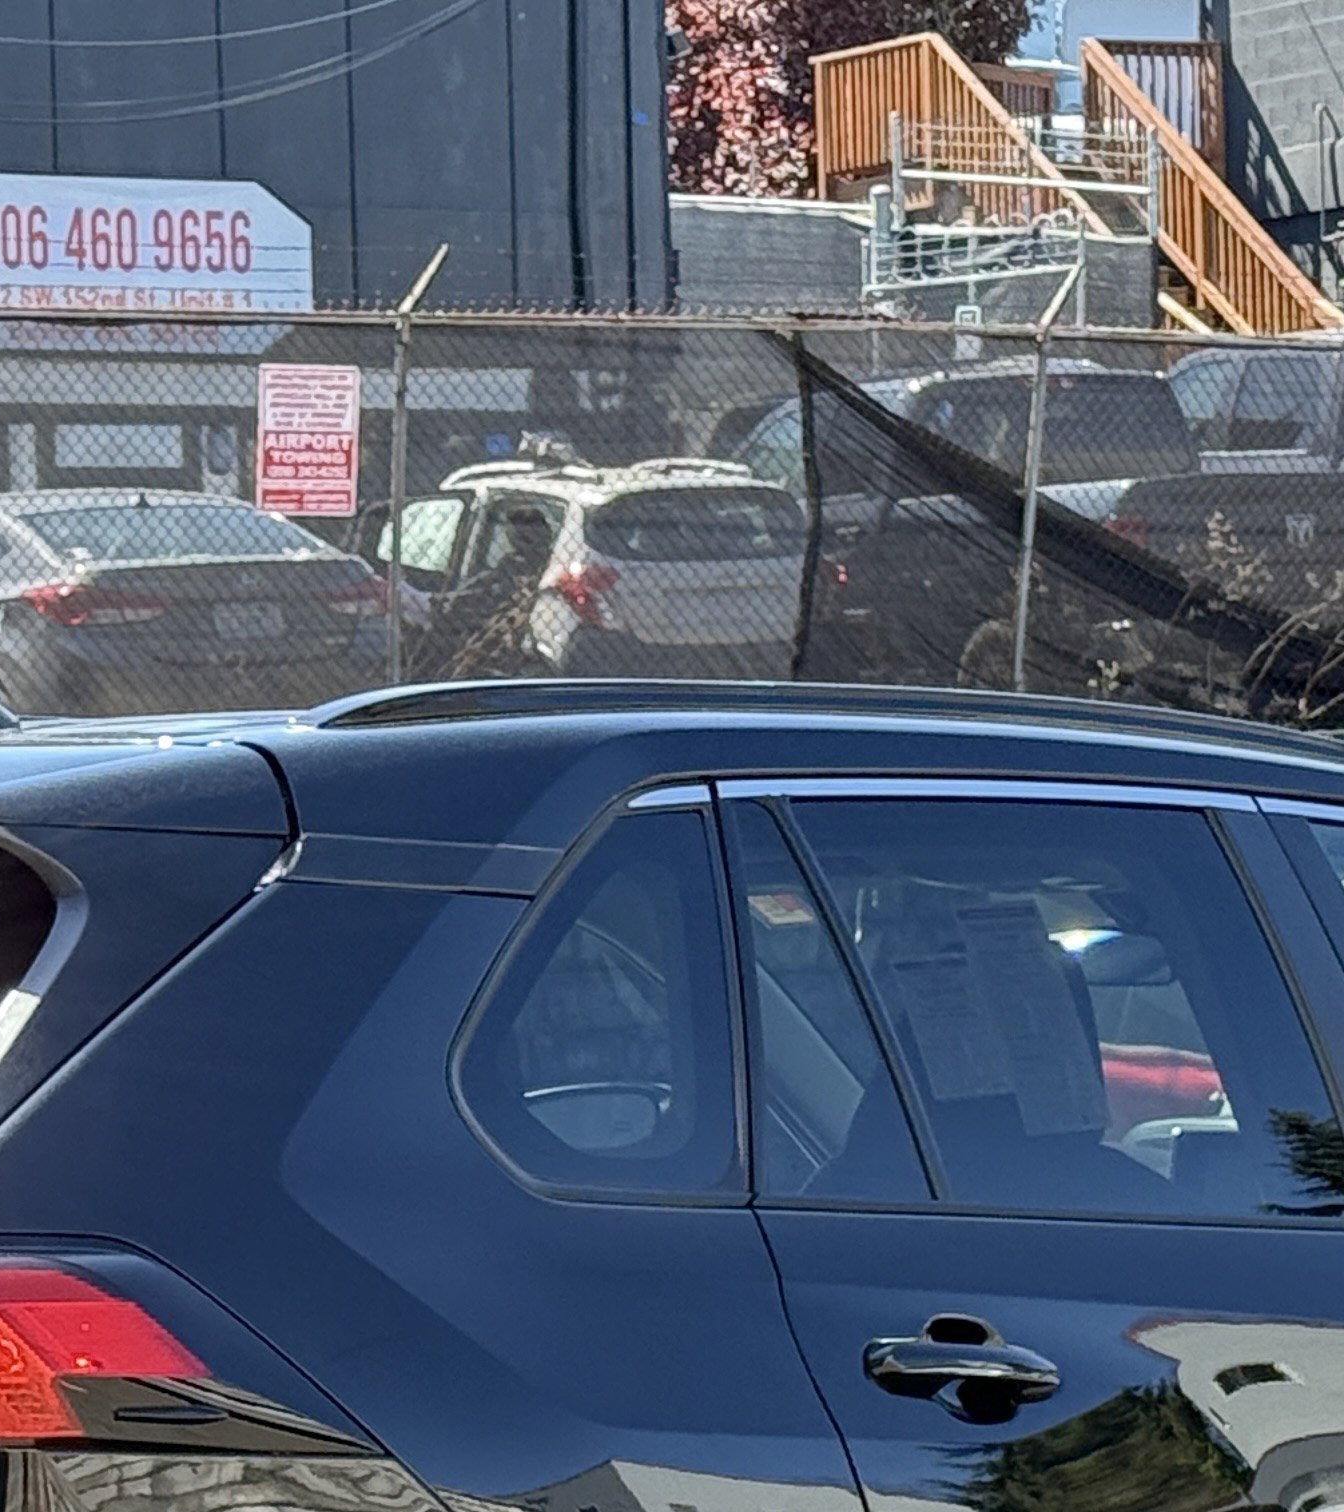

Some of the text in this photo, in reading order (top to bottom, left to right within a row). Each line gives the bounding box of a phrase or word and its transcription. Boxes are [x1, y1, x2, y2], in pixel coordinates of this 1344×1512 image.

[64, 206, 137, 272] 460
[153, 208, 252, 274] 9656
[264, 432, 354, 452] AIRPORT
[268, 449, 348, 466] TOWING
